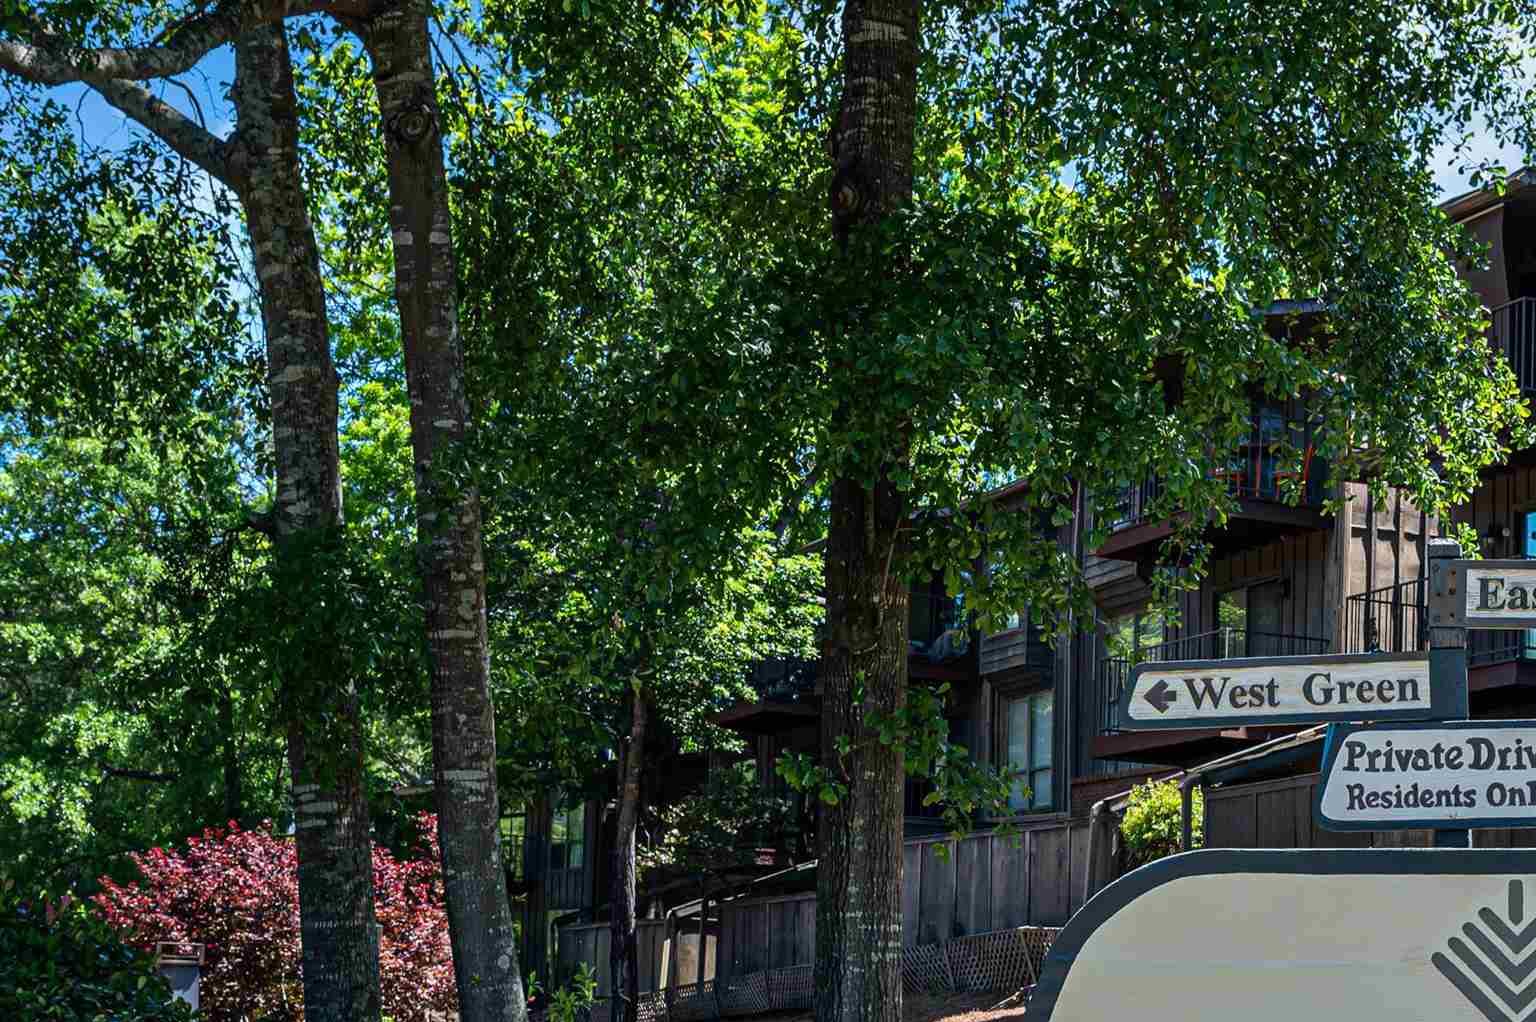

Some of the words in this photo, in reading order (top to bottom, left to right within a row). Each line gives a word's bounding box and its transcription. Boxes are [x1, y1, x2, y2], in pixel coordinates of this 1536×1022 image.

[1184, 670, 1280, 711] West
[1302, 665, 1421, 706] Green
[1342, 738, 1464, 774] Private
[1346, 782, 1477, 811] Residents
